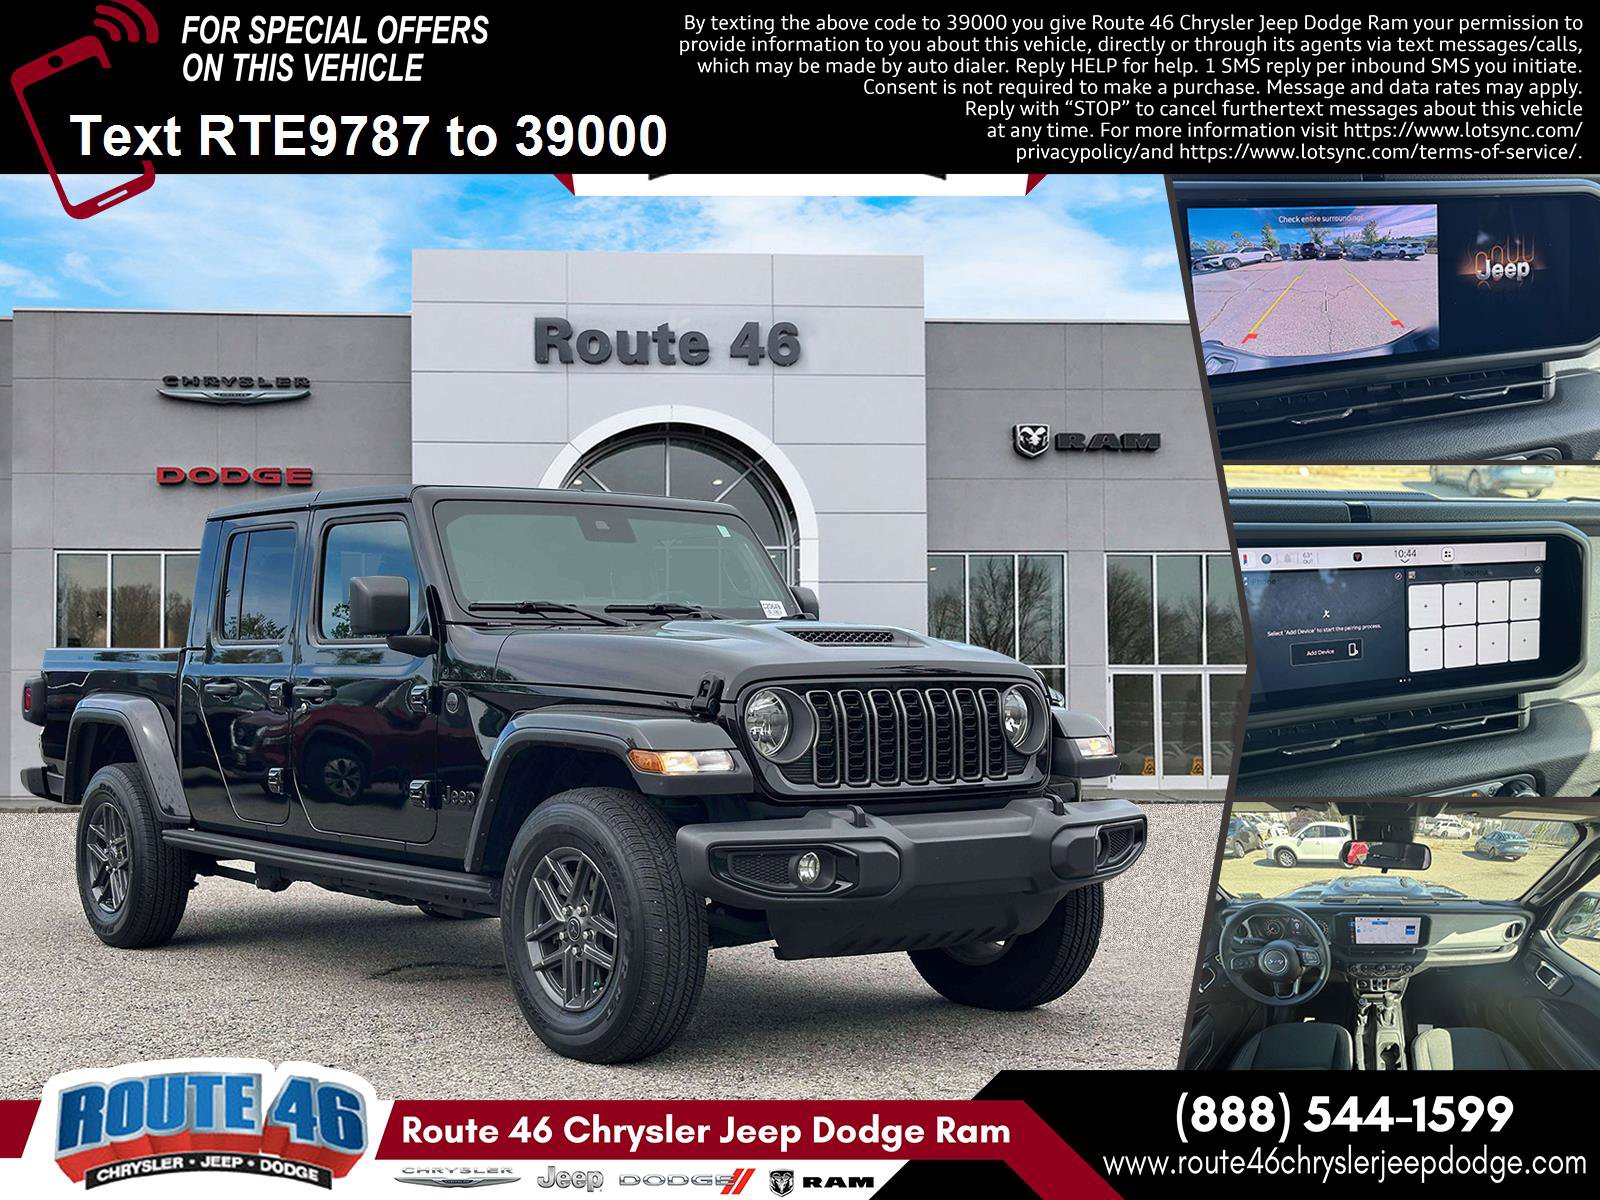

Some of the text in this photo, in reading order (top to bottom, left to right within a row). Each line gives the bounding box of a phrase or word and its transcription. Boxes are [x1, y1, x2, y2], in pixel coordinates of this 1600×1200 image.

[1279, 215, 1300, 224] Check
[1301, 215, 1321, 223] entire
[1476, 259, 1530, 281] Jeep
[534, 317, 802, 367] Route 46
[161, 375, 312, 389] CHRYSLER
[1055, 433, 1162, 452] RAM
[156, 466, 313, 486] DODGE
[1394, 549, 1417, 558] 10:44
[442, 785, 476, 808] Jeep
